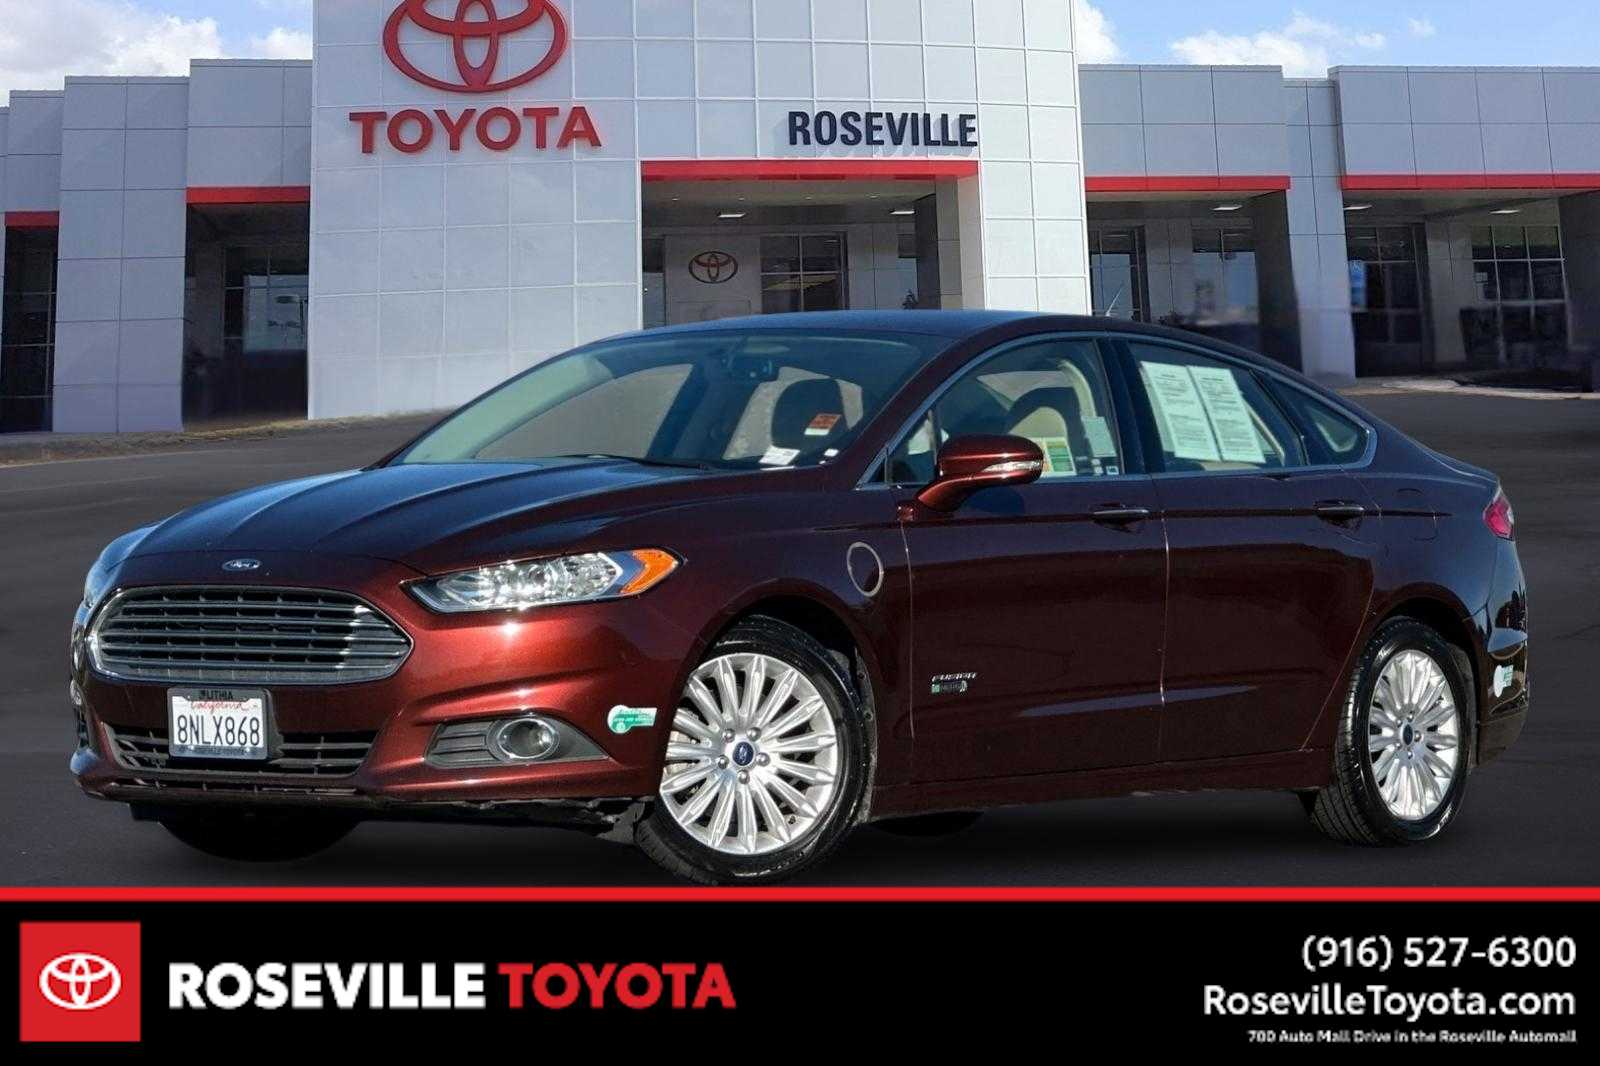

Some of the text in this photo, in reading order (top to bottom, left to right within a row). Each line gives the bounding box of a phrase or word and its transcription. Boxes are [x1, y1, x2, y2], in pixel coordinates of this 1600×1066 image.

[349, 106, 602, 154] TOYOTA
[788, 110, 979, 147] ROSEVILLE
[177, 714, 260, 746] 8NLX868
